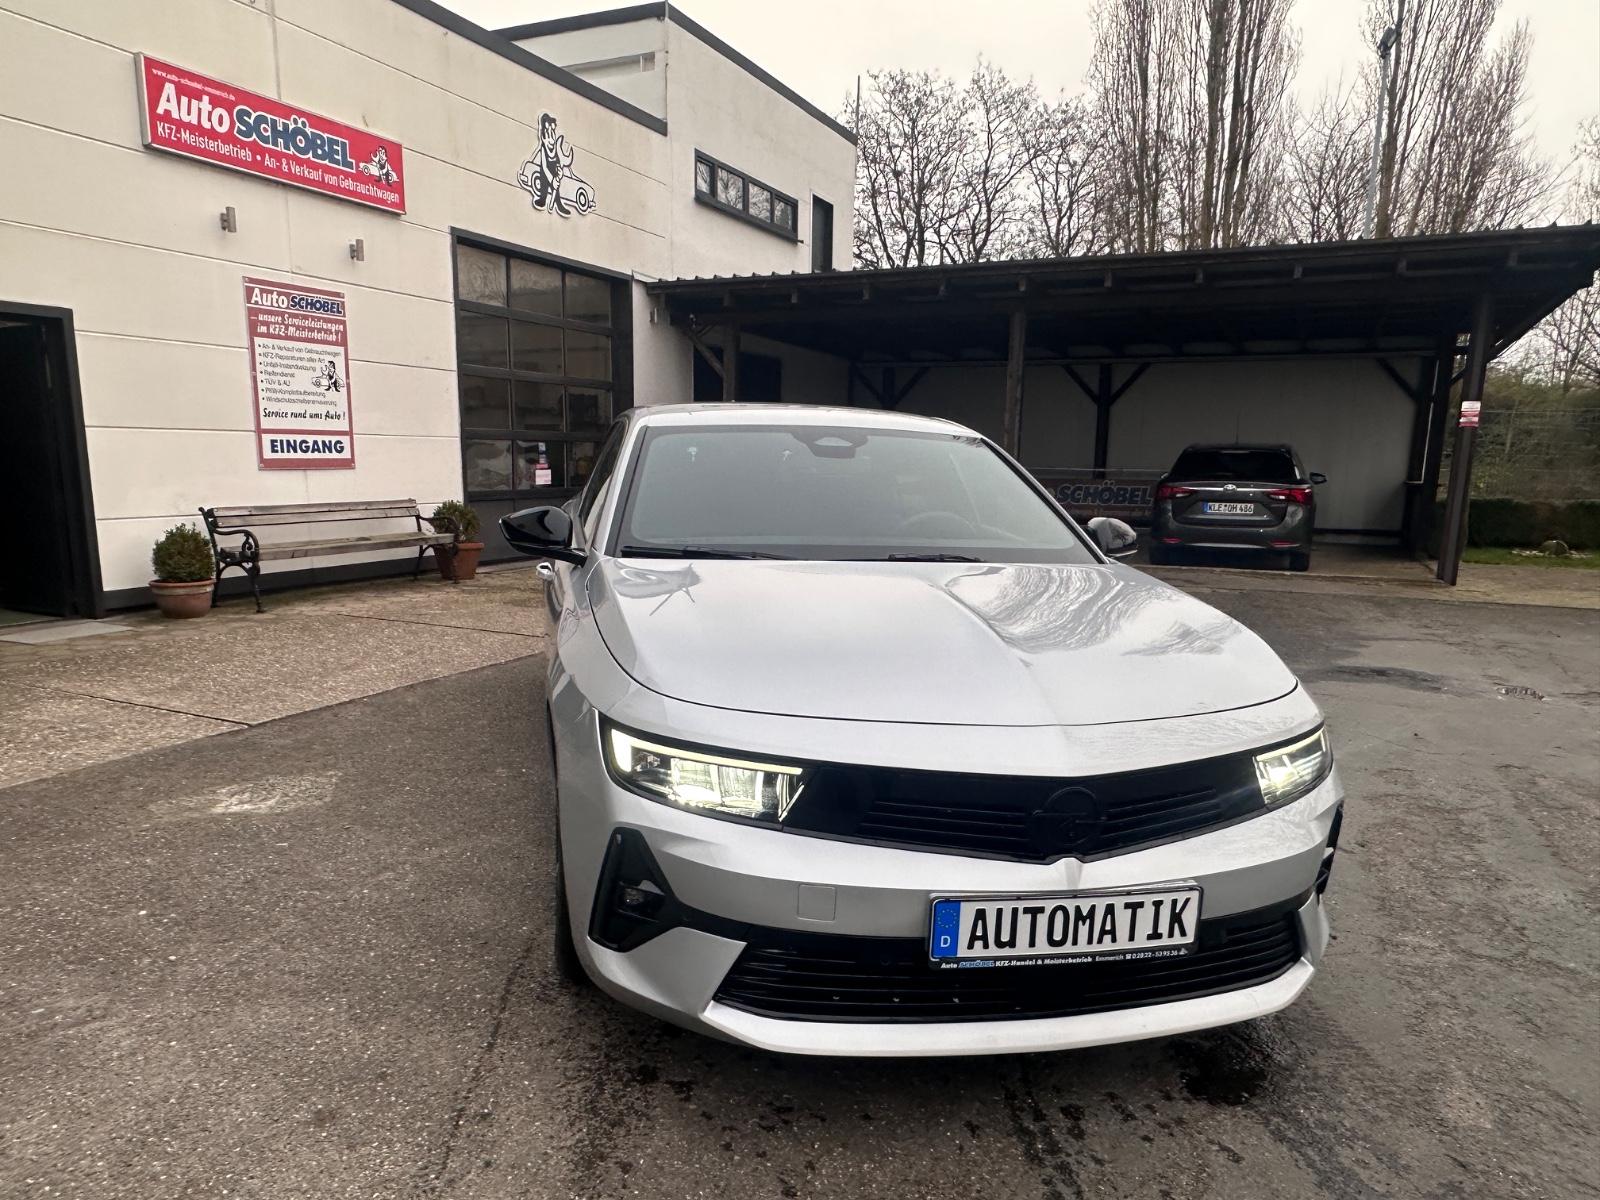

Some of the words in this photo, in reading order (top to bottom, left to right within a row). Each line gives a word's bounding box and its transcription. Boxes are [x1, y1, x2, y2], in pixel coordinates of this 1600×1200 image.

[156, 82, 230, 133] Auto
[234, 105, 356, 173] SCHÖBEL
[157, 121, 252, 162] KFZ-Meisterbetrieb
[264, 153, 280, 169] An-
[281, 158, 289, 172] &
[290, 159, 322, 180] Verkauf
[324, 173, 338, 186] von
[340, 175, 400, 204] Gebrauchtwagen
[250, 288, 288, 309] Auto
[289, 294, 344, 316] SCHÖBEL
[258, 313, 282, 323] unsere
[284, 314, 344, 332] Serviceleistungen
[257, 323, 267, 333] im
[269, 324, 337, 342] KFZ-Meisterbetrieb
[263, 407, 289, 419] Service
[290, 409, 307, 419] rund
[309, 412, 323, 420] ums
[324, 410, 341, 421] Auto
[270, 438, 345, 454] EINGANG
[1056, 480, 1154, 506] SCHÖBEL
[1208, 503, 1223, 511] KLE
[966, 897, 1192, 950] AUTOMATIK
[940, 935, 951, 947] D
